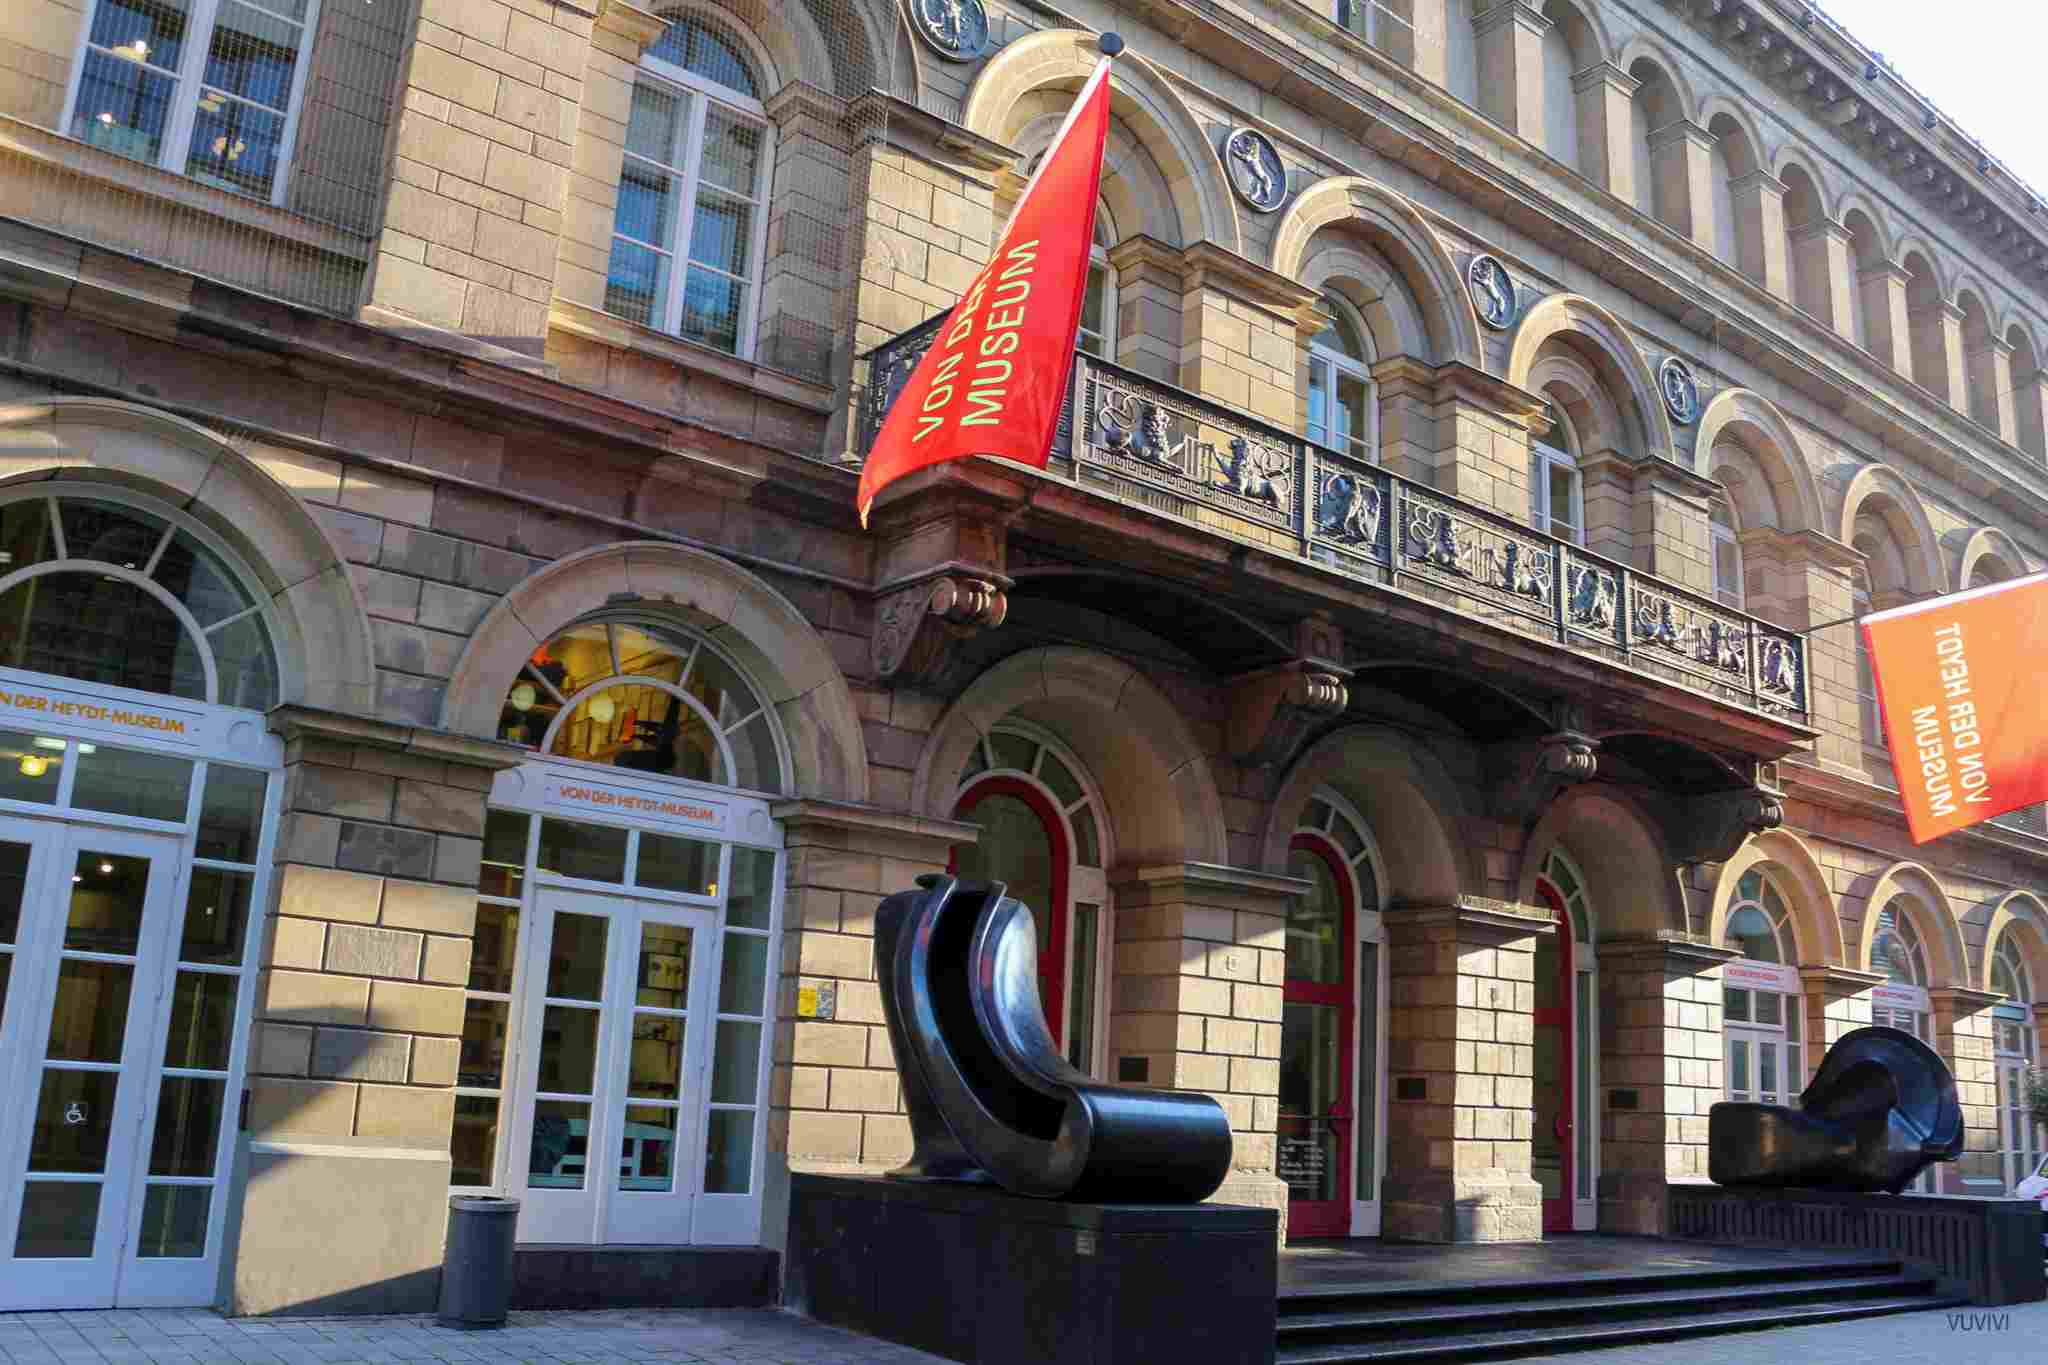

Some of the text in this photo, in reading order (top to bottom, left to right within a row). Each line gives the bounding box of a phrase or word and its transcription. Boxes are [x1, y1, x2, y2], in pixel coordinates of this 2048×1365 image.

[960, 239, 1040, 426] MUSEUM
[912, 352, 964, 443] VON
[15, 694, 48, 713] DER
[52, 701, 184, 733] HEYDT-MUSEUM
[560, 785, 592, 800] VON
[592, 791, 617, 806] DER
